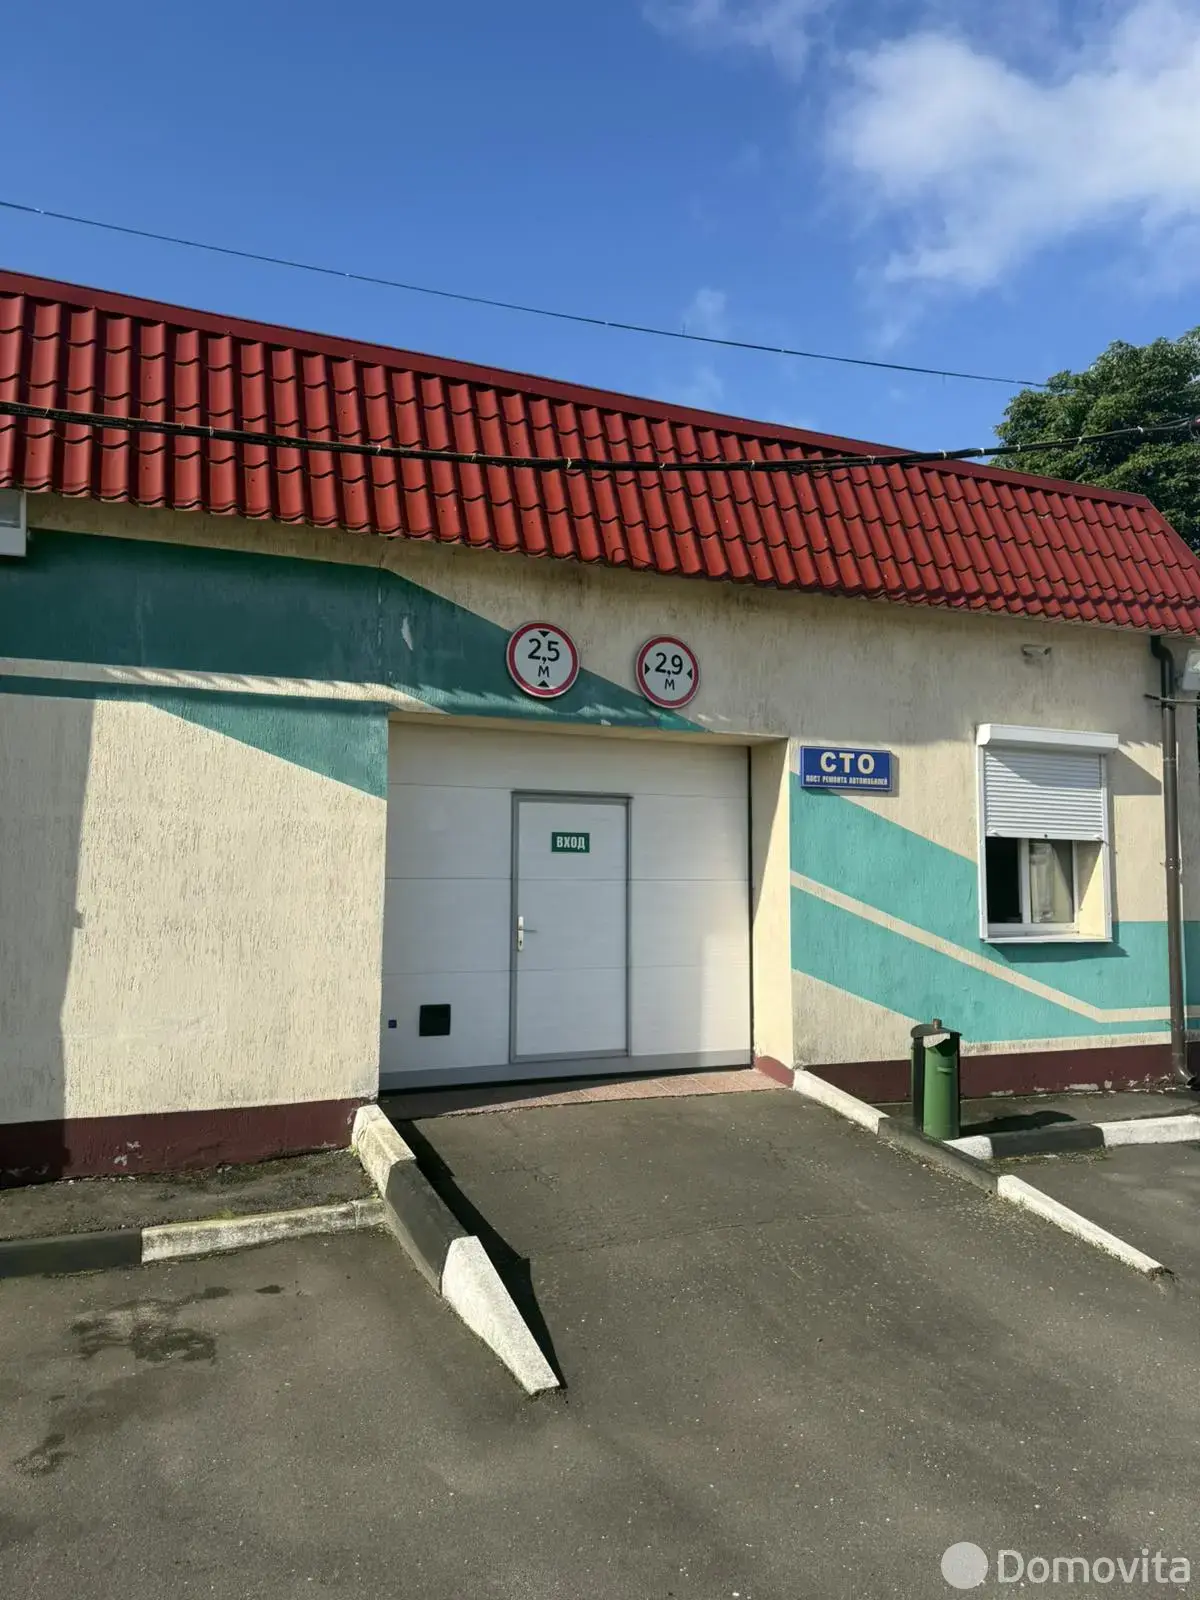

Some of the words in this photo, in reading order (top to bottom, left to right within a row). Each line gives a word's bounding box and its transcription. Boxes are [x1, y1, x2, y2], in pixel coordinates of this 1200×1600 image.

[527, 638, 560, 665] 2,5
[654, 652, 683, 676] 2,9
[820, 751, 875, 775] СТО
[556, 836, 586, 850] ВХОД
